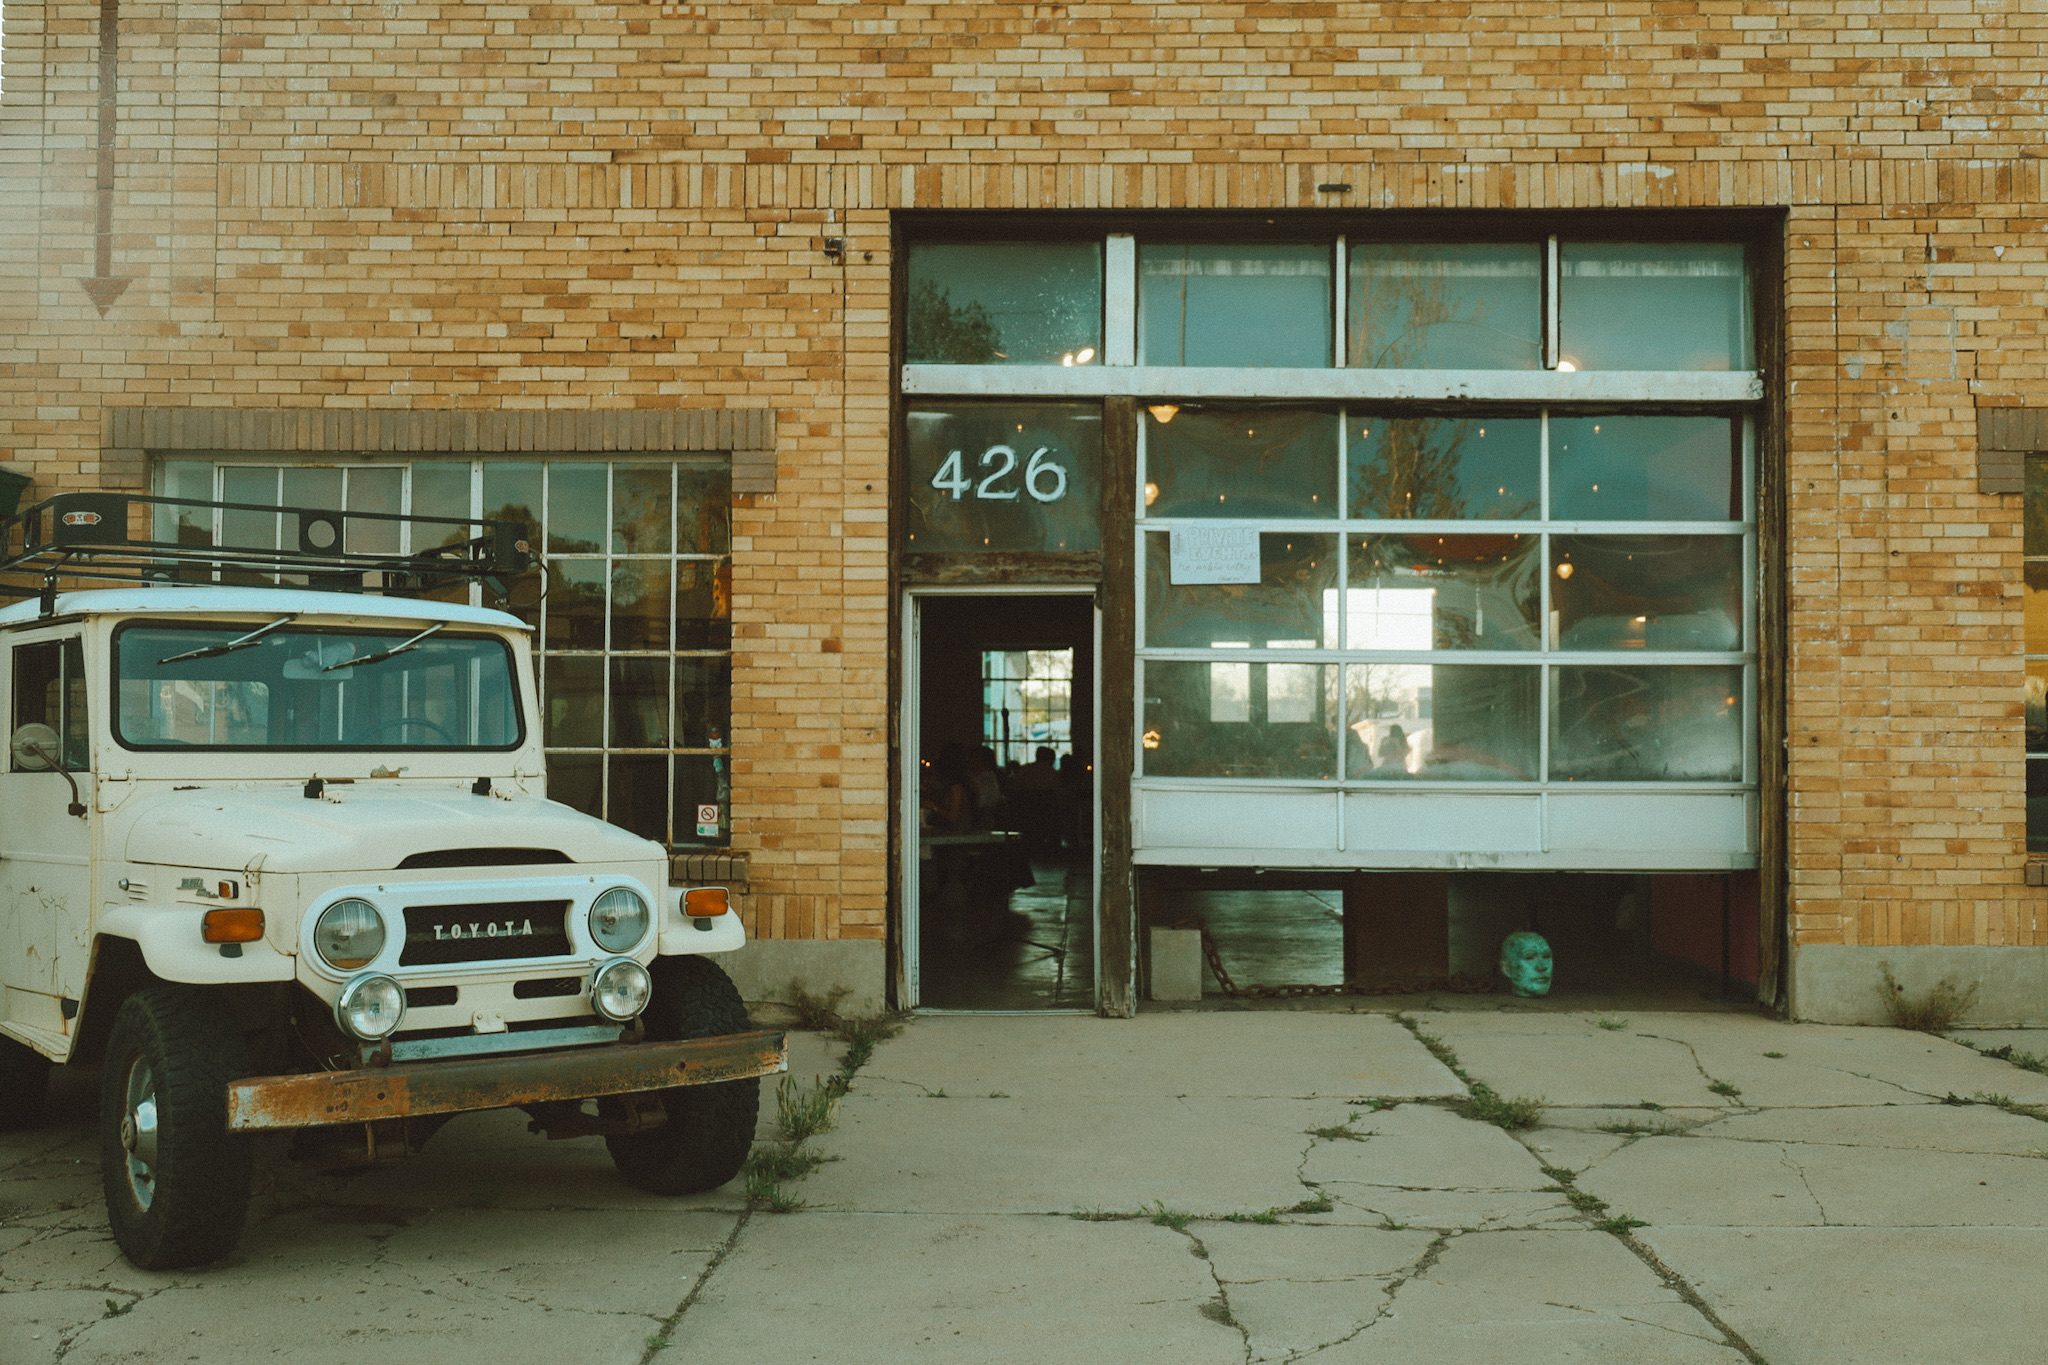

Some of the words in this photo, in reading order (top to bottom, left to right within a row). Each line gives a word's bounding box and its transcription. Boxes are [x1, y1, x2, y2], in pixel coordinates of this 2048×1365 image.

[931, 444, 1067, 503] 426
[1188, 526, 1254, 546] PRIVATE
[1189, 546, 1244, 561] EVENT
[433, 919, 533, 940] TOYOTA
